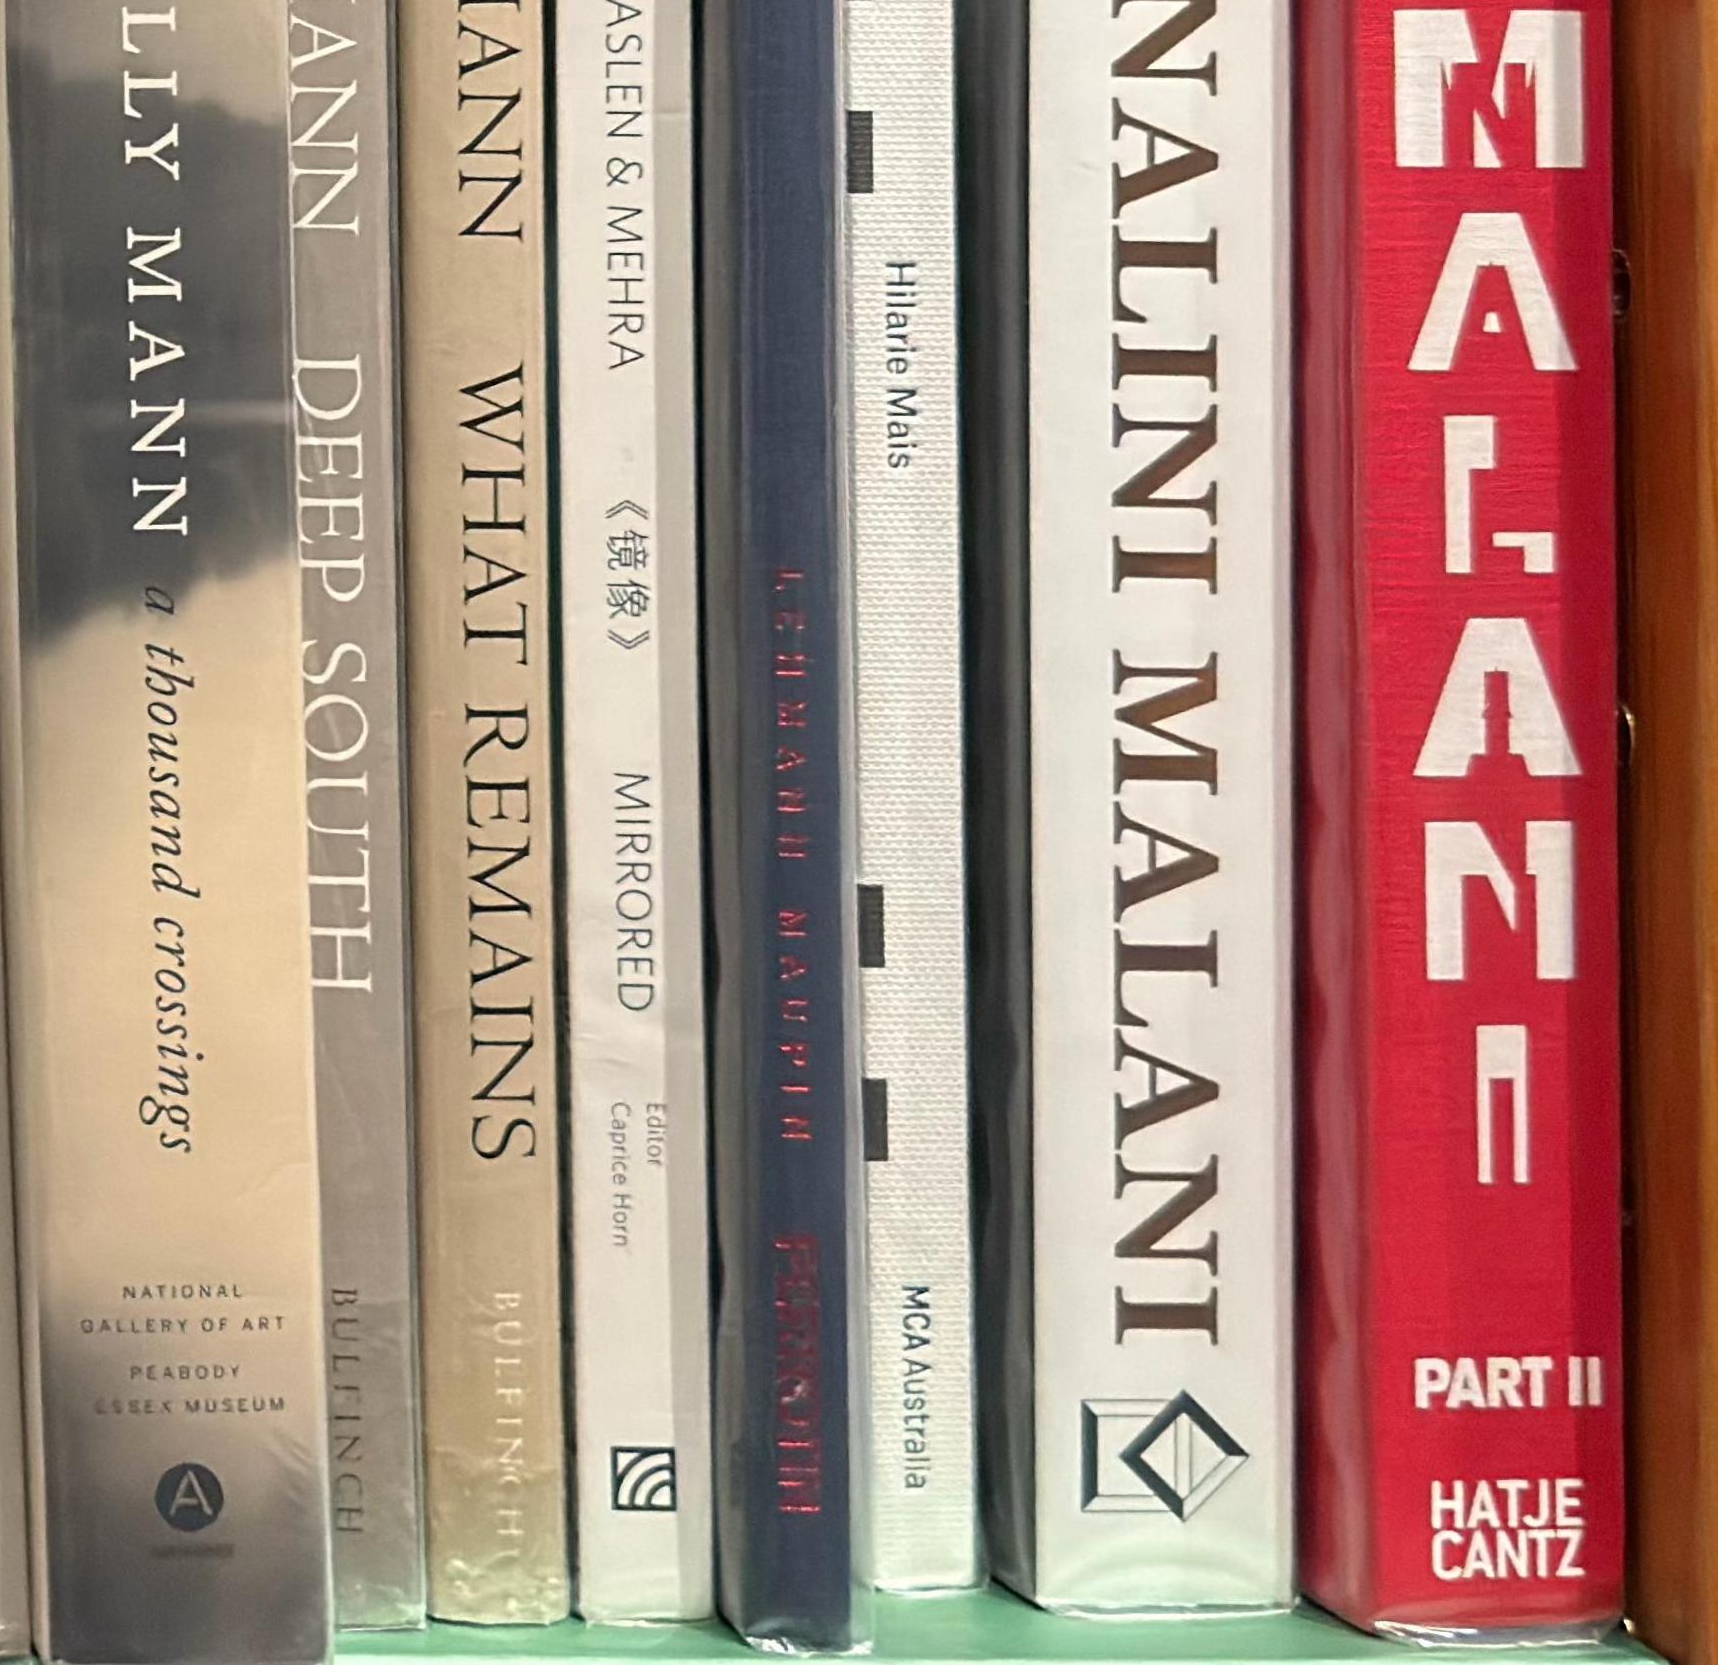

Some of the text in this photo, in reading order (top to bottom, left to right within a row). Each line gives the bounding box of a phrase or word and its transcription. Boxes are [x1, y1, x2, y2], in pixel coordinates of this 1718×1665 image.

[605, 157, 644, 187] &
[606, 205, 646, 372] MEHRA
[885, 261, 917, 469] Hilarie Mais
[125, 226, 188, 537] MANN
[144, 584, 175, 616] a
[292, 354, 372, 993] DEEP SOUTH
[143, 642, 201, 900] thousand
[459, 361, 536, 1161] WHAT REMAINS
[613, 771, 654, 1013] MIRRORED
[139, 914, 204, 1154] crossings
[778, 909, 813, 1142] MAUPIN
[1112, 649, 1220, 1345] MALANI
[610, 1101, 633, 1248] Caprice Horn
[646, 1100, 666, 1167] Editor
[81, 1316, 285, 1334] GALLERY OF ART
[122, 1285, 243, 1299] NATIONAL
[130, 1365, 240, 1380] PEABODY
[185, 1397, 285, 1414] MUSEUM
[331, 1287, 363, 1533] BULFINCH
[901, 1285, 929, 1490] MCA Australia
[1415, 1356, 1603, 1408] PART II
[1431, 1479, 1584, 1529] HATJE
[1432, 1530, 1586, 1580] CANTZ
